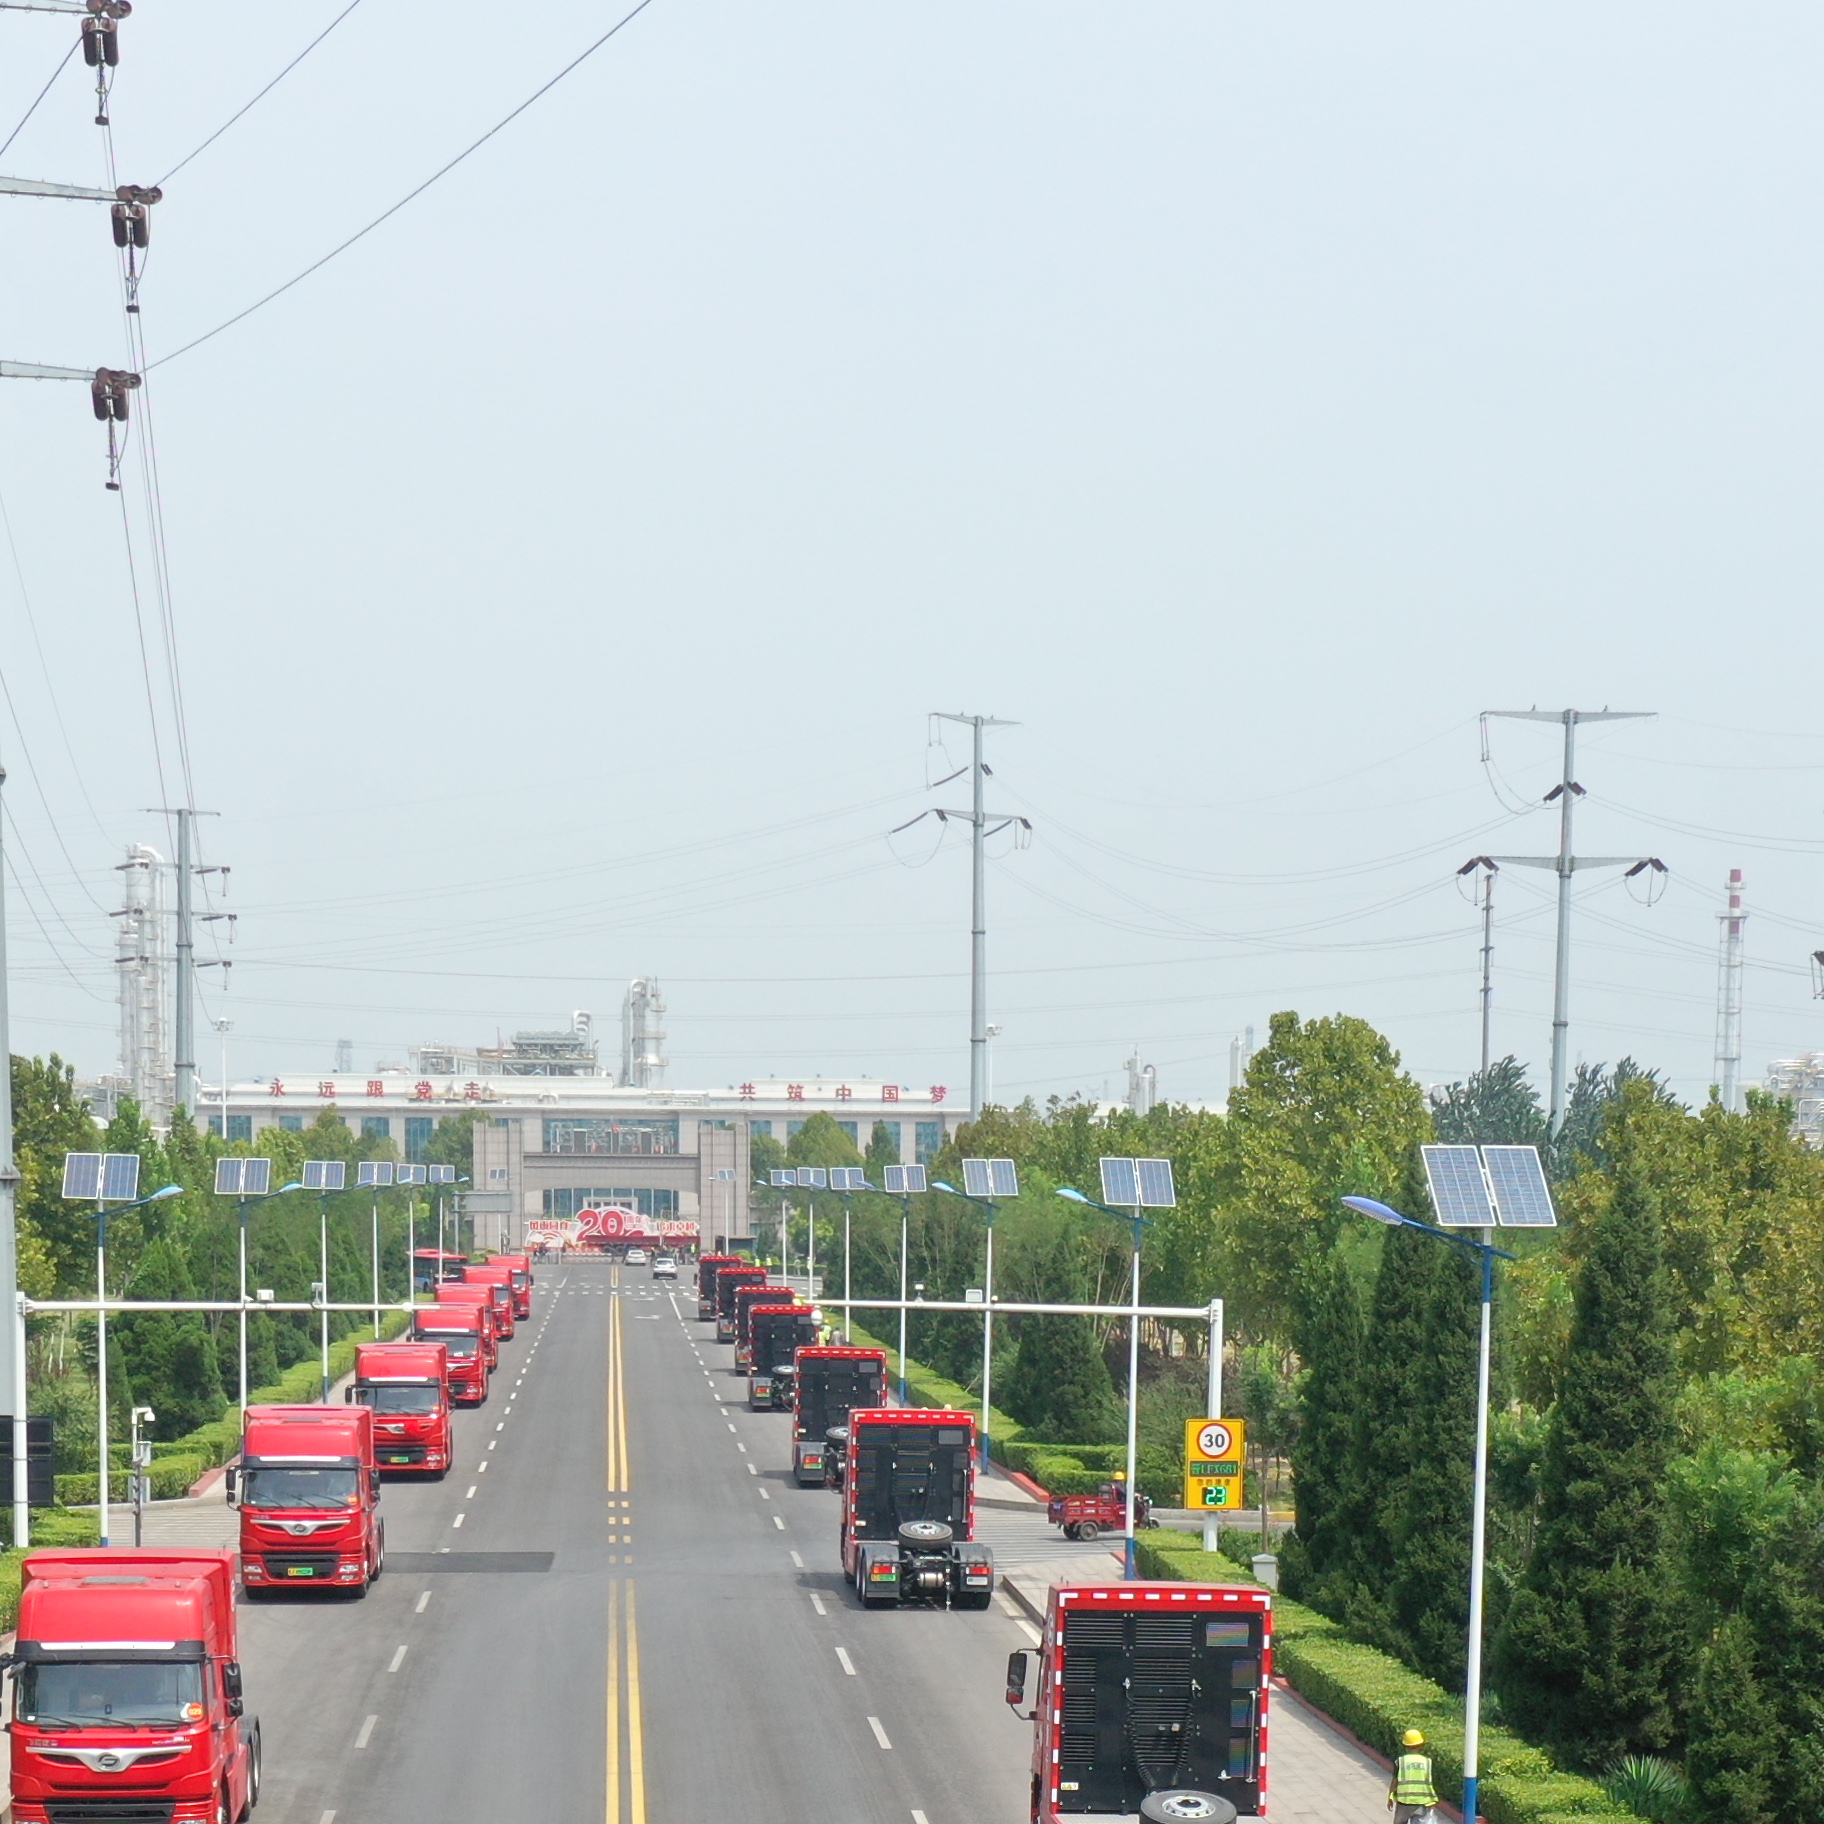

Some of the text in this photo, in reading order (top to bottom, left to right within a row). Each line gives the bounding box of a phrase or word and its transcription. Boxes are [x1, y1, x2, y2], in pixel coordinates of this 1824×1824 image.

[269, 1078, 481, 1100] 永远跟党走
[739, 1083, 947, 1103] 共筑中国梦
[577, 1210, 624, 1242] 20
[1204, 1434, 1225, 1448] 30
[1206, 1487, 1225, 1505] 23
